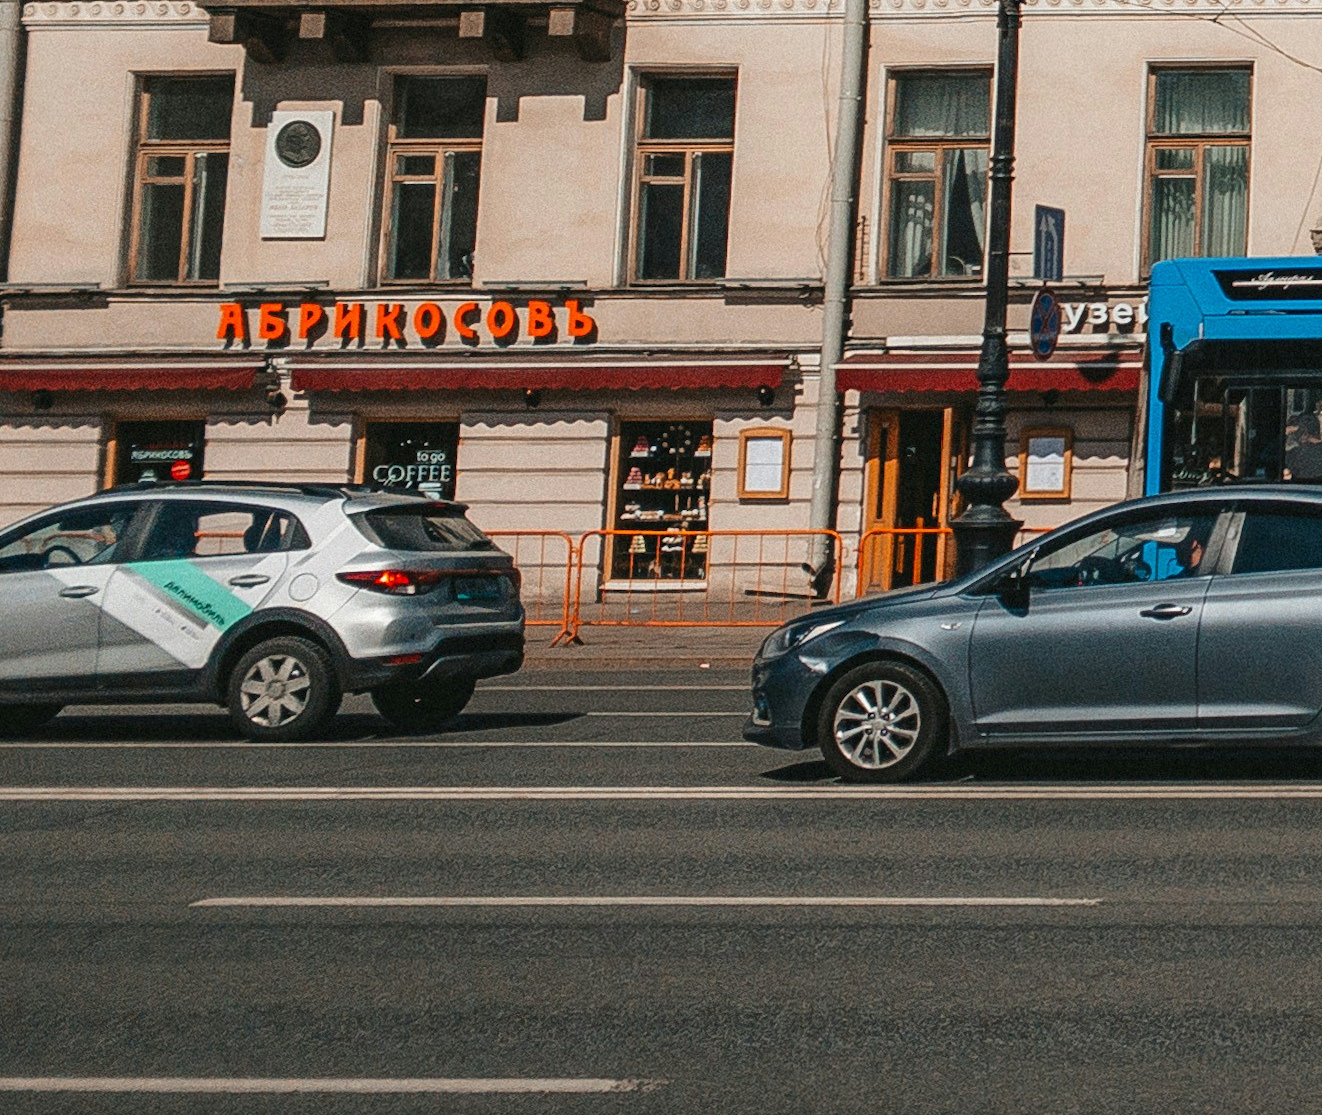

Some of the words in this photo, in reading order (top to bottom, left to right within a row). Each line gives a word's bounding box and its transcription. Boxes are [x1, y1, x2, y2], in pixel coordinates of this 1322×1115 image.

[216, 300, 594, 340] АБРИКОСОВЪ
[416, 451, 429, 462] to
[430, 452, 446, 464] go
[372, 464, 451, 483] COFFEE
